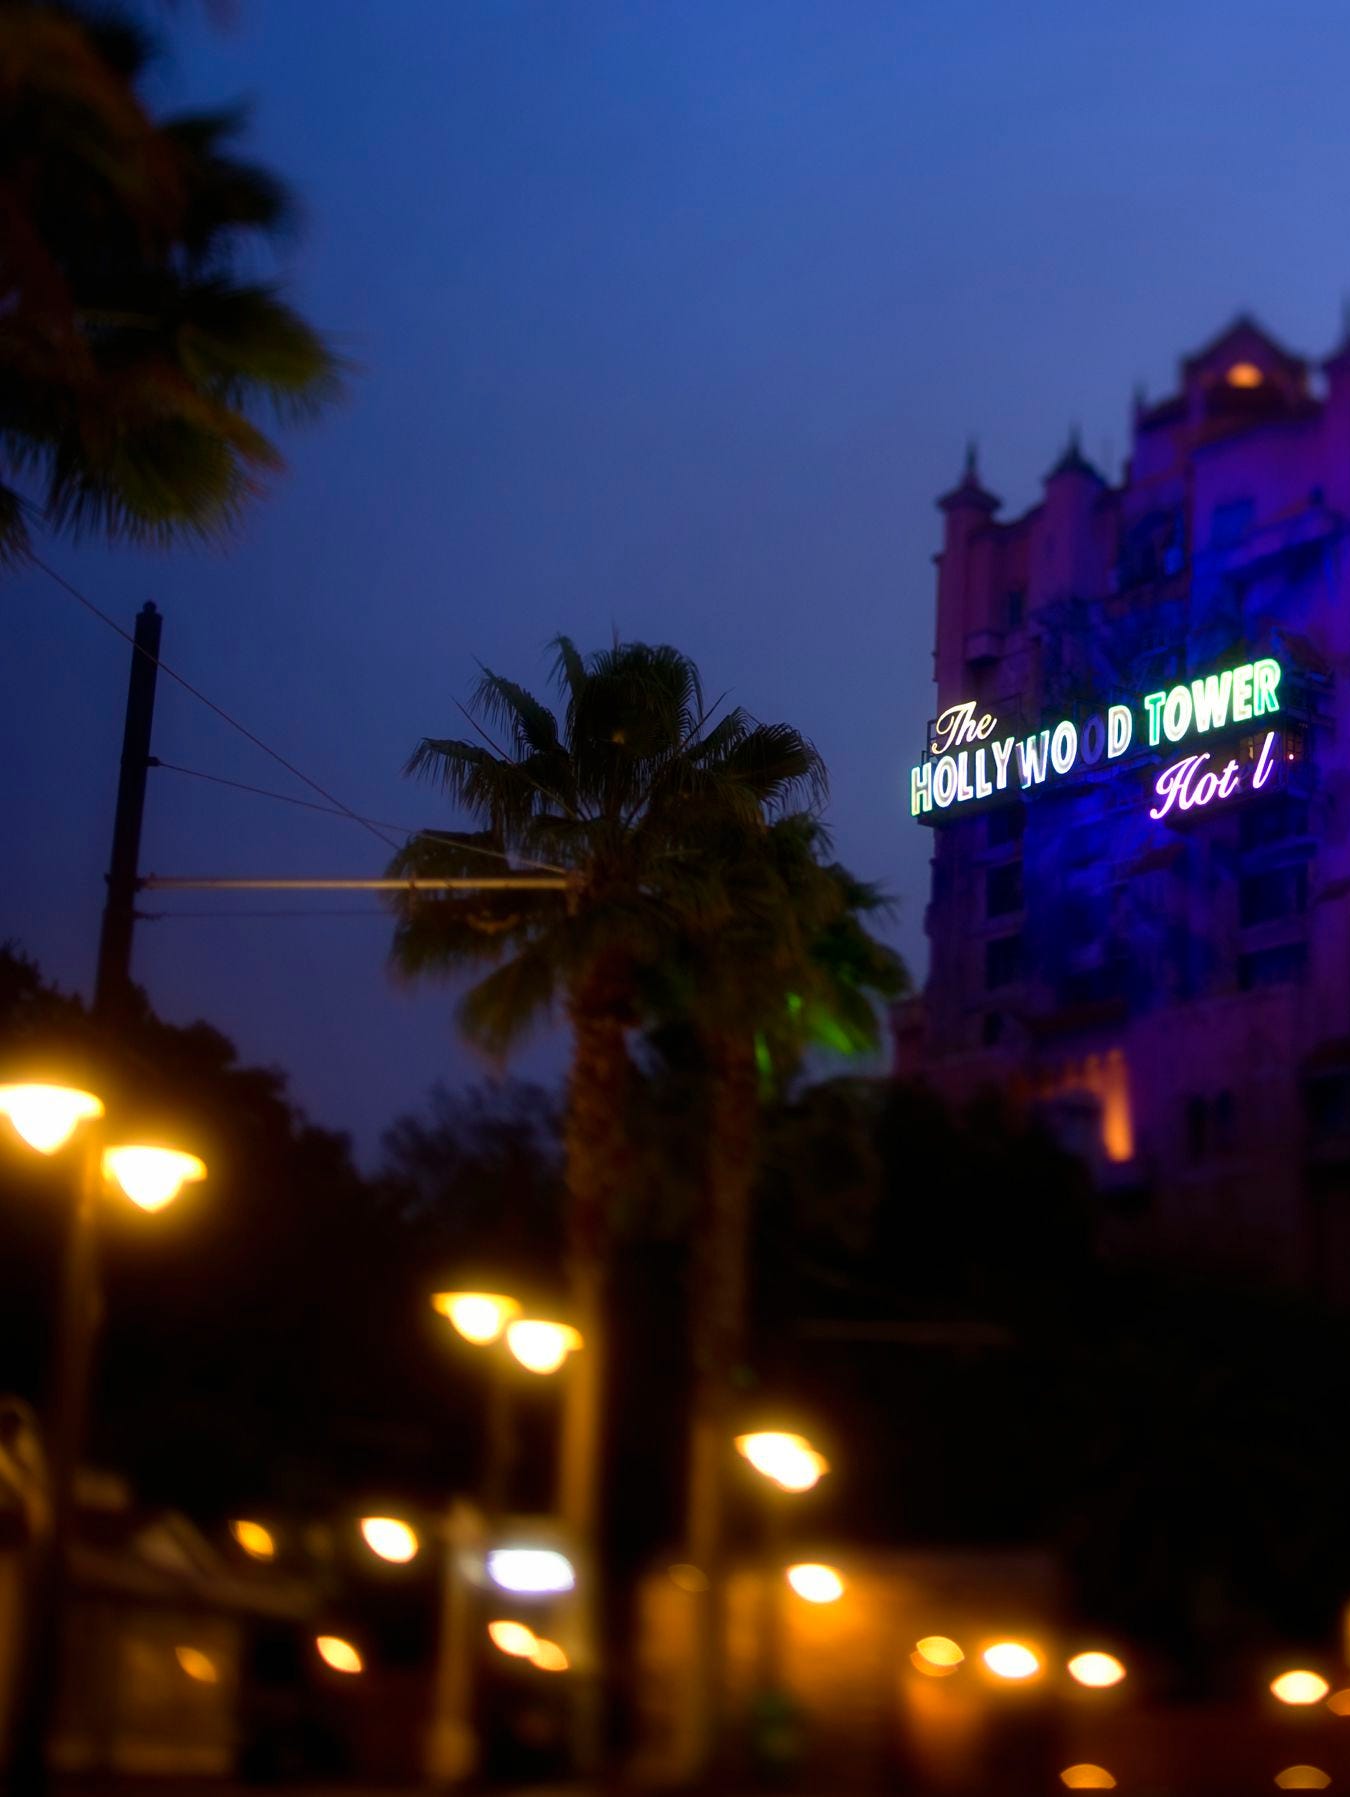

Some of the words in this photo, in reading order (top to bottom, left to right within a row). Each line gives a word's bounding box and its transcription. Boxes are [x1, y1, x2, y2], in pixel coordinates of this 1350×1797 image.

[910, 704, 1133, 817] HOLLYWOOD
[1144, 658, 1282, 747] TOWER
[931, 701, 998, 755] The
[1149, 731, 1276, 820] Hotl
